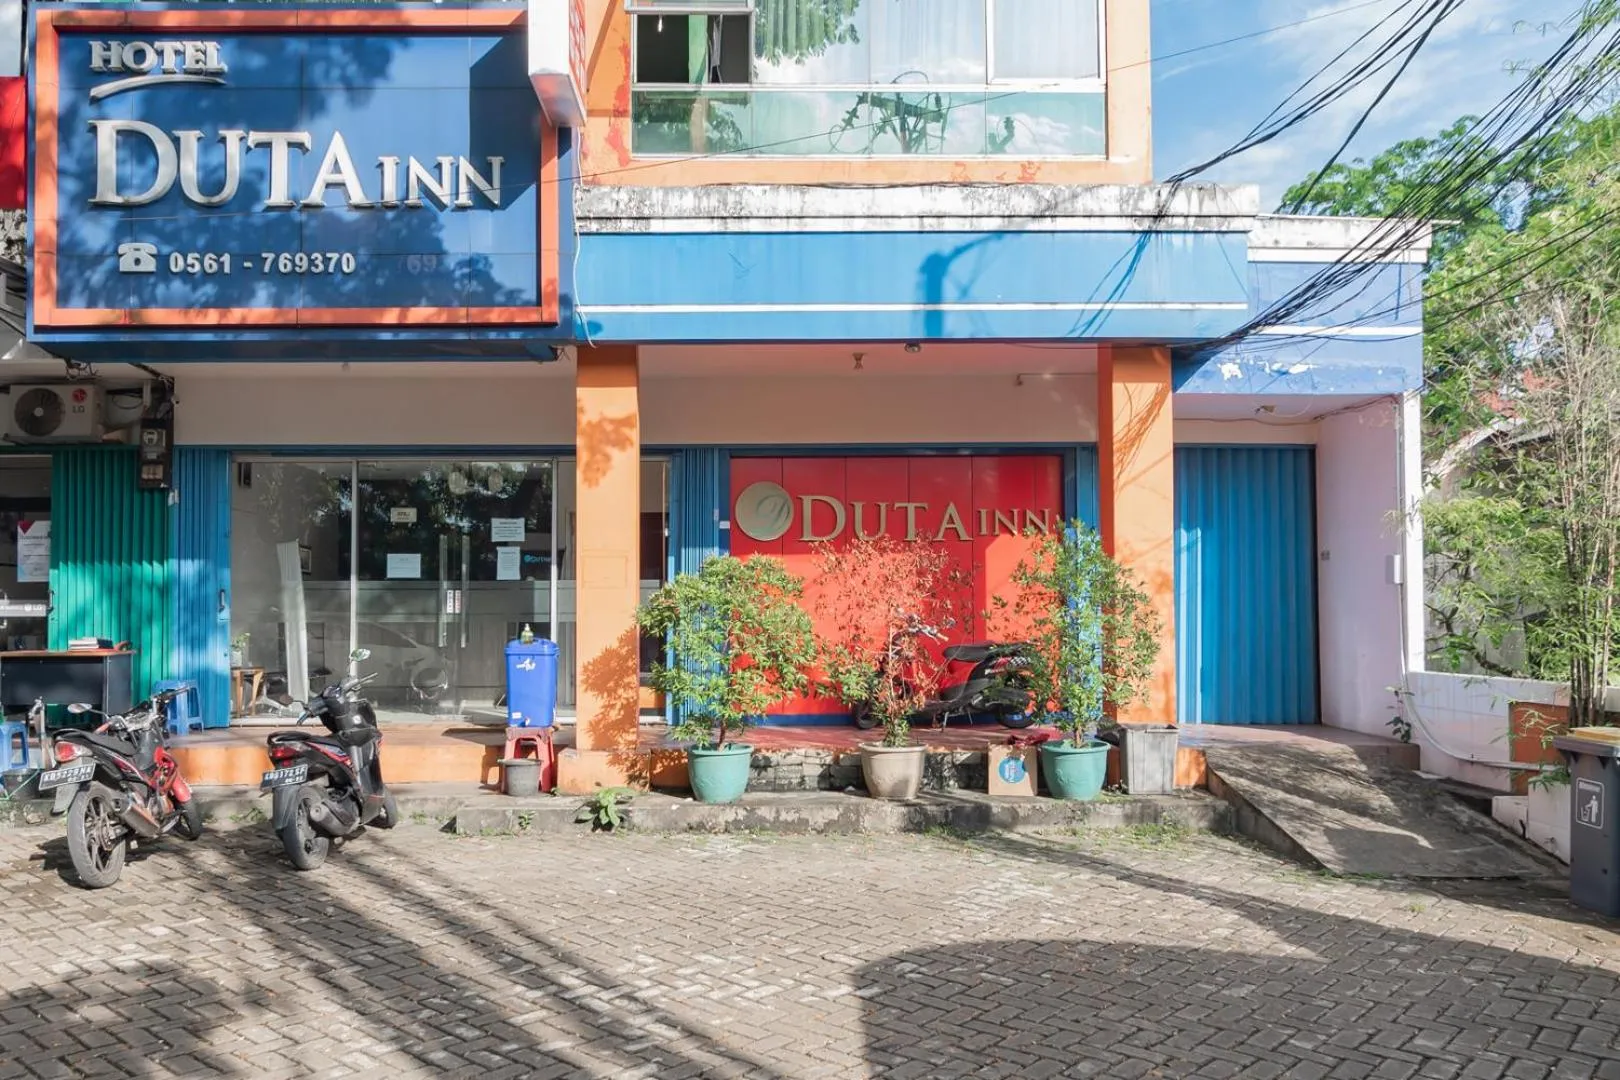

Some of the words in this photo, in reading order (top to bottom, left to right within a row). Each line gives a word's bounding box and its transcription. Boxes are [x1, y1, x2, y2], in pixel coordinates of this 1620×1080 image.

[88, 40, 228, 73] HOTEL
[87, 119, 373, 208] DUTA
[377, 155, 506, 208] INN
[168, 251, 232, 274] 0561
[261, 252, 357, 274] 769370
[797, 495, 975, 542] DUTA
[978, 507, 1050, 537] INN
